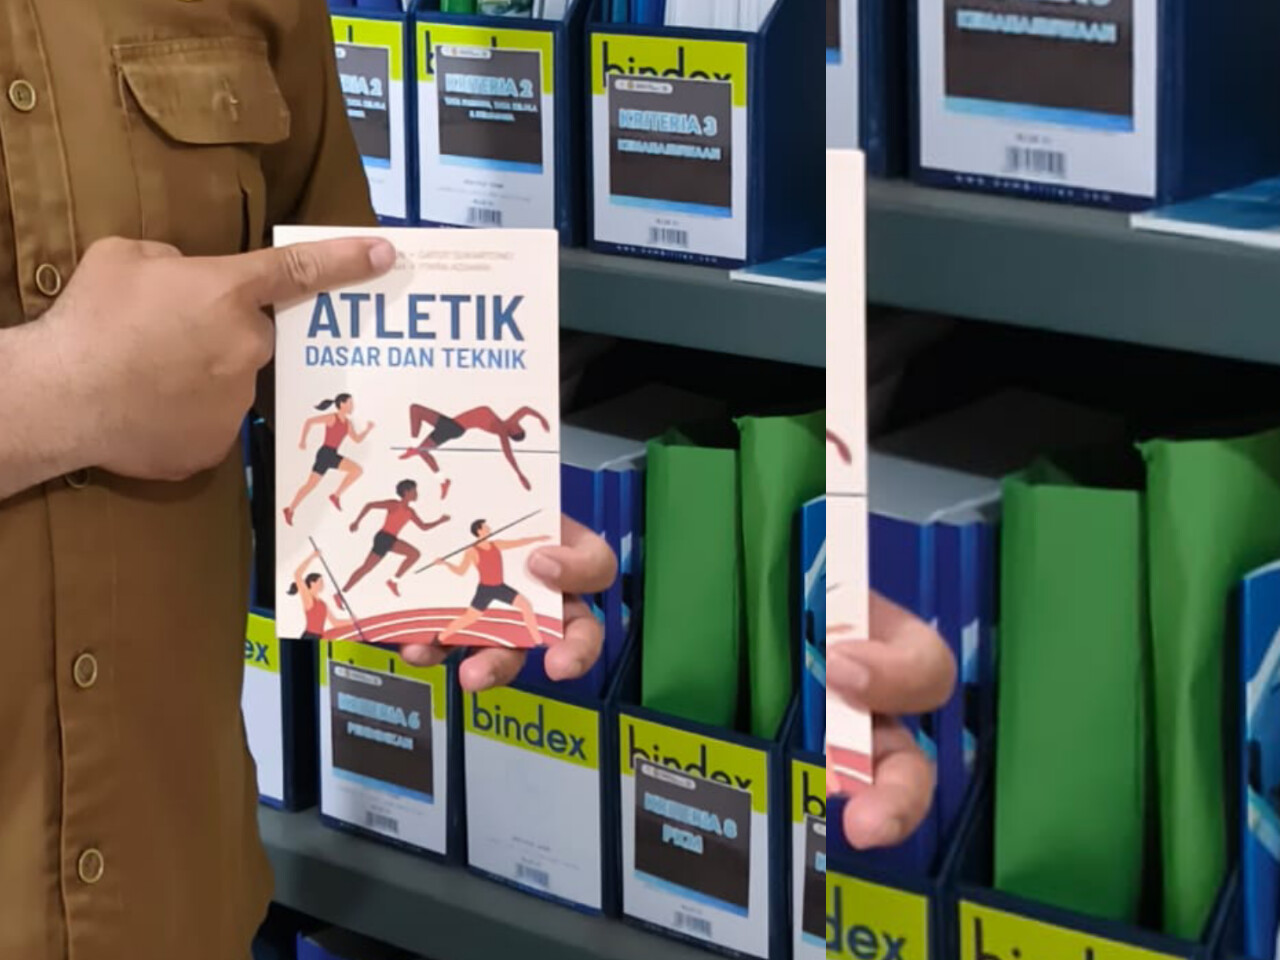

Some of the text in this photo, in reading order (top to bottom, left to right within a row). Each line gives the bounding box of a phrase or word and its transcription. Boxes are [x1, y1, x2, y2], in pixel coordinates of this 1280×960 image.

[369, 77, 383, 98] 2
[519, 78, 534, 98] 2
[703, 115, 718, 137] 3
[307, 292, 525, 341] ATLETIK
[305, 345, 527, 370] DASAR DAN TEKNIK
[472, 690, 587, 761] bindex
